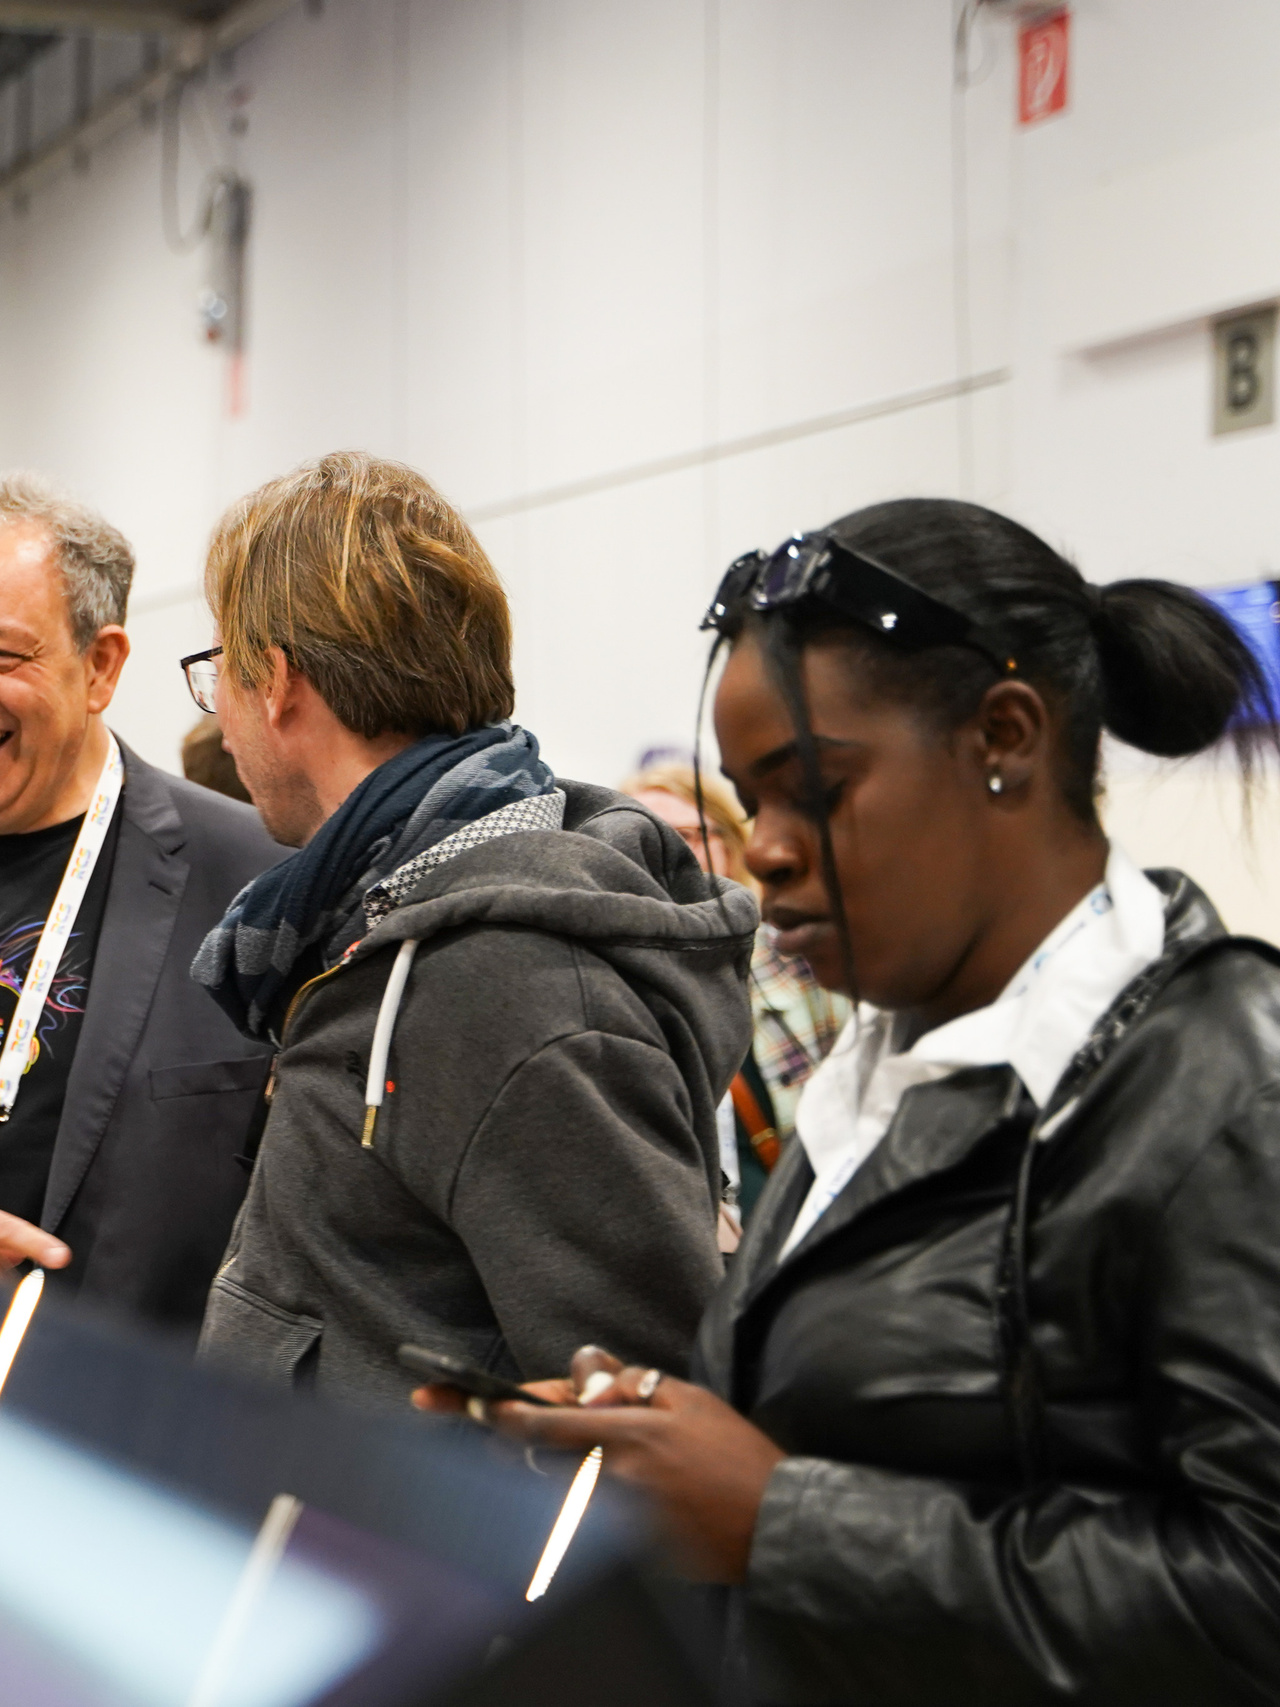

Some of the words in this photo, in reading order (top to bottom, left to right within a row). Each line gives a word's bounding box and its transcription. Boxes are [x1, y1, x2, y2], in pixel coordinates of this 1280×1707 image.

[91, 794, 110, 825] RCS
[71, 848, 91, 879] RCS
[50, 902, 72, 935] RCS
[29, 958, 50, 992] RCS
[11, 1018, 30, 1053] RCS
